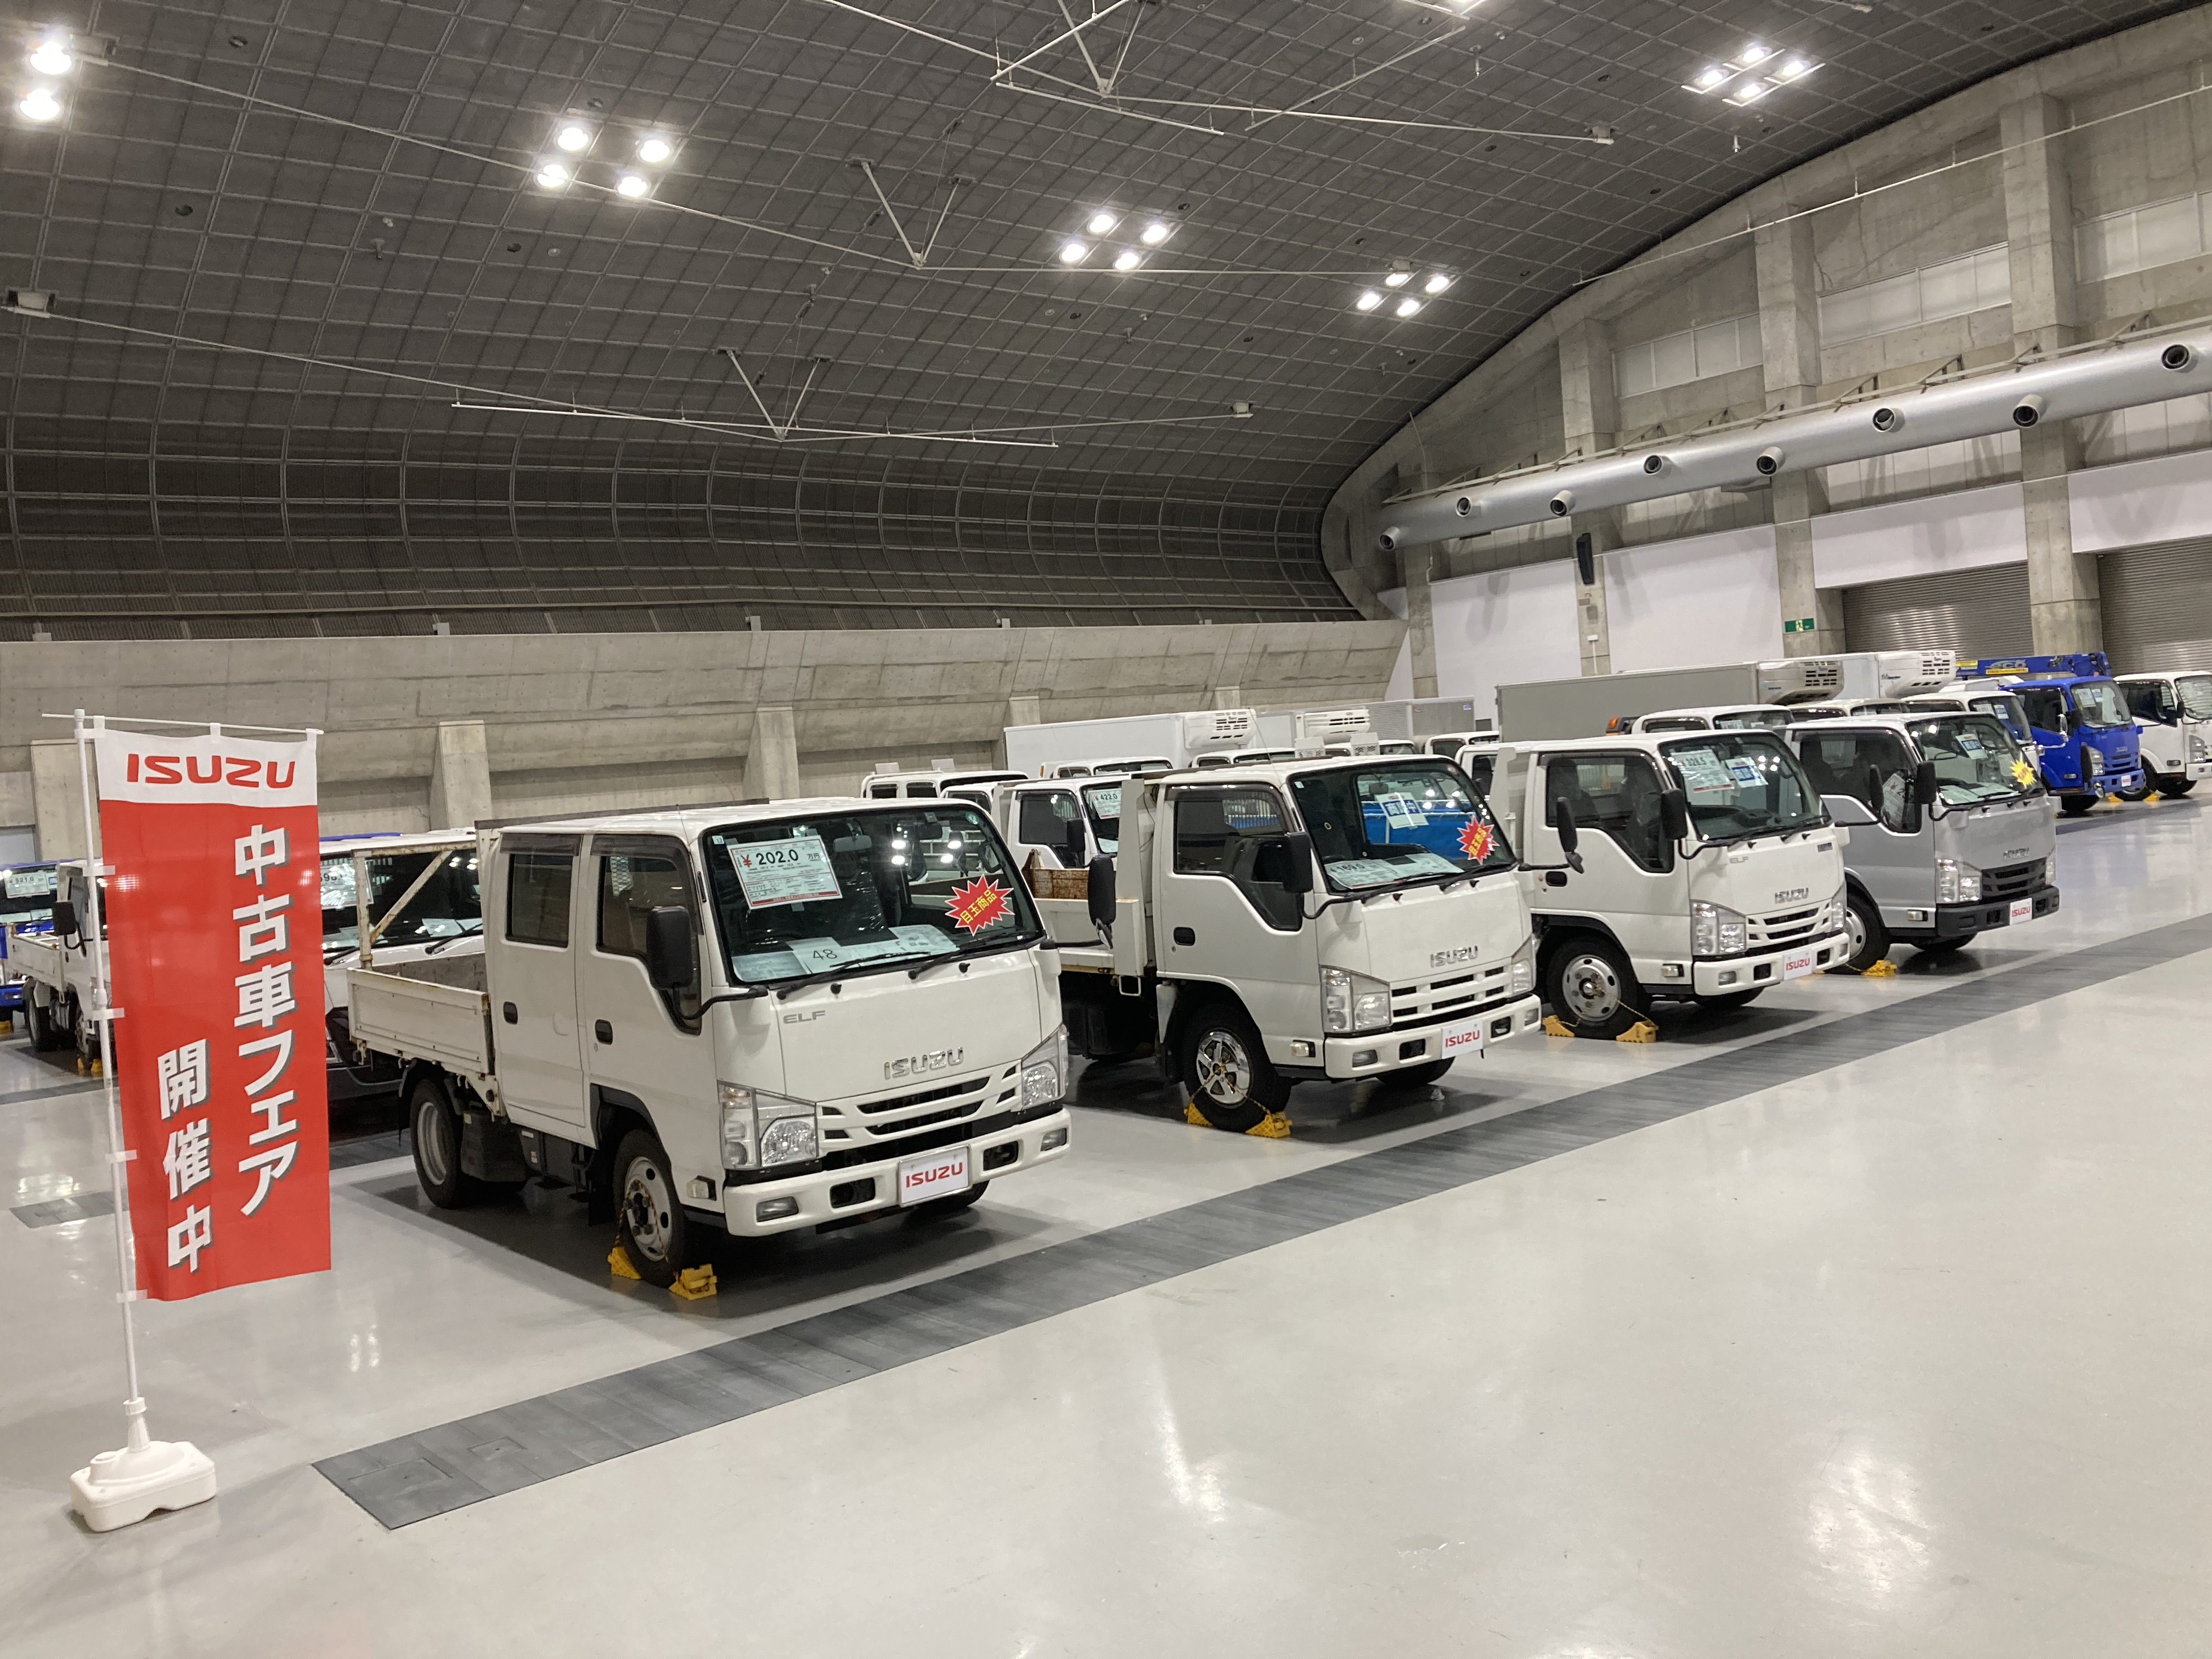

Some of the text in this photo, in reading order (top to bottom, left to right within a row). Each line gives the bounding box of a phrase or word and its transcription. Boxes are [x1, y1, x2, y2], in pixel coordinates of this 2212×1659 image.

[127, 753, 295, 789] ISUZU
[741, 854, 752, 868] ¥
[755, 849, 799, 865] 202.0
[1729, 856, 1749, 864] ELF
[1774, 887, 1809, 904] ISUZU
[960, 889, 997, 924] 目玉商品
[2012, 906, 2031, 917] ISUZU
[812, 949, 838, 960] 48
[1430, 945, 1479, 968] ISUZU
[1786, 958, 1810, 971] ISUZU
[233, 824, 299, 1217] 中古車フェア
[783, 1010, 826, 1024] ELF
[1445, 1030, 1480, 1048] ISUZU
[884, 1046, 963, 1080] ISUZU
[157, 1038, 213, 1274] 開催中
[905, 1161, 963, 1188] ISUZU
